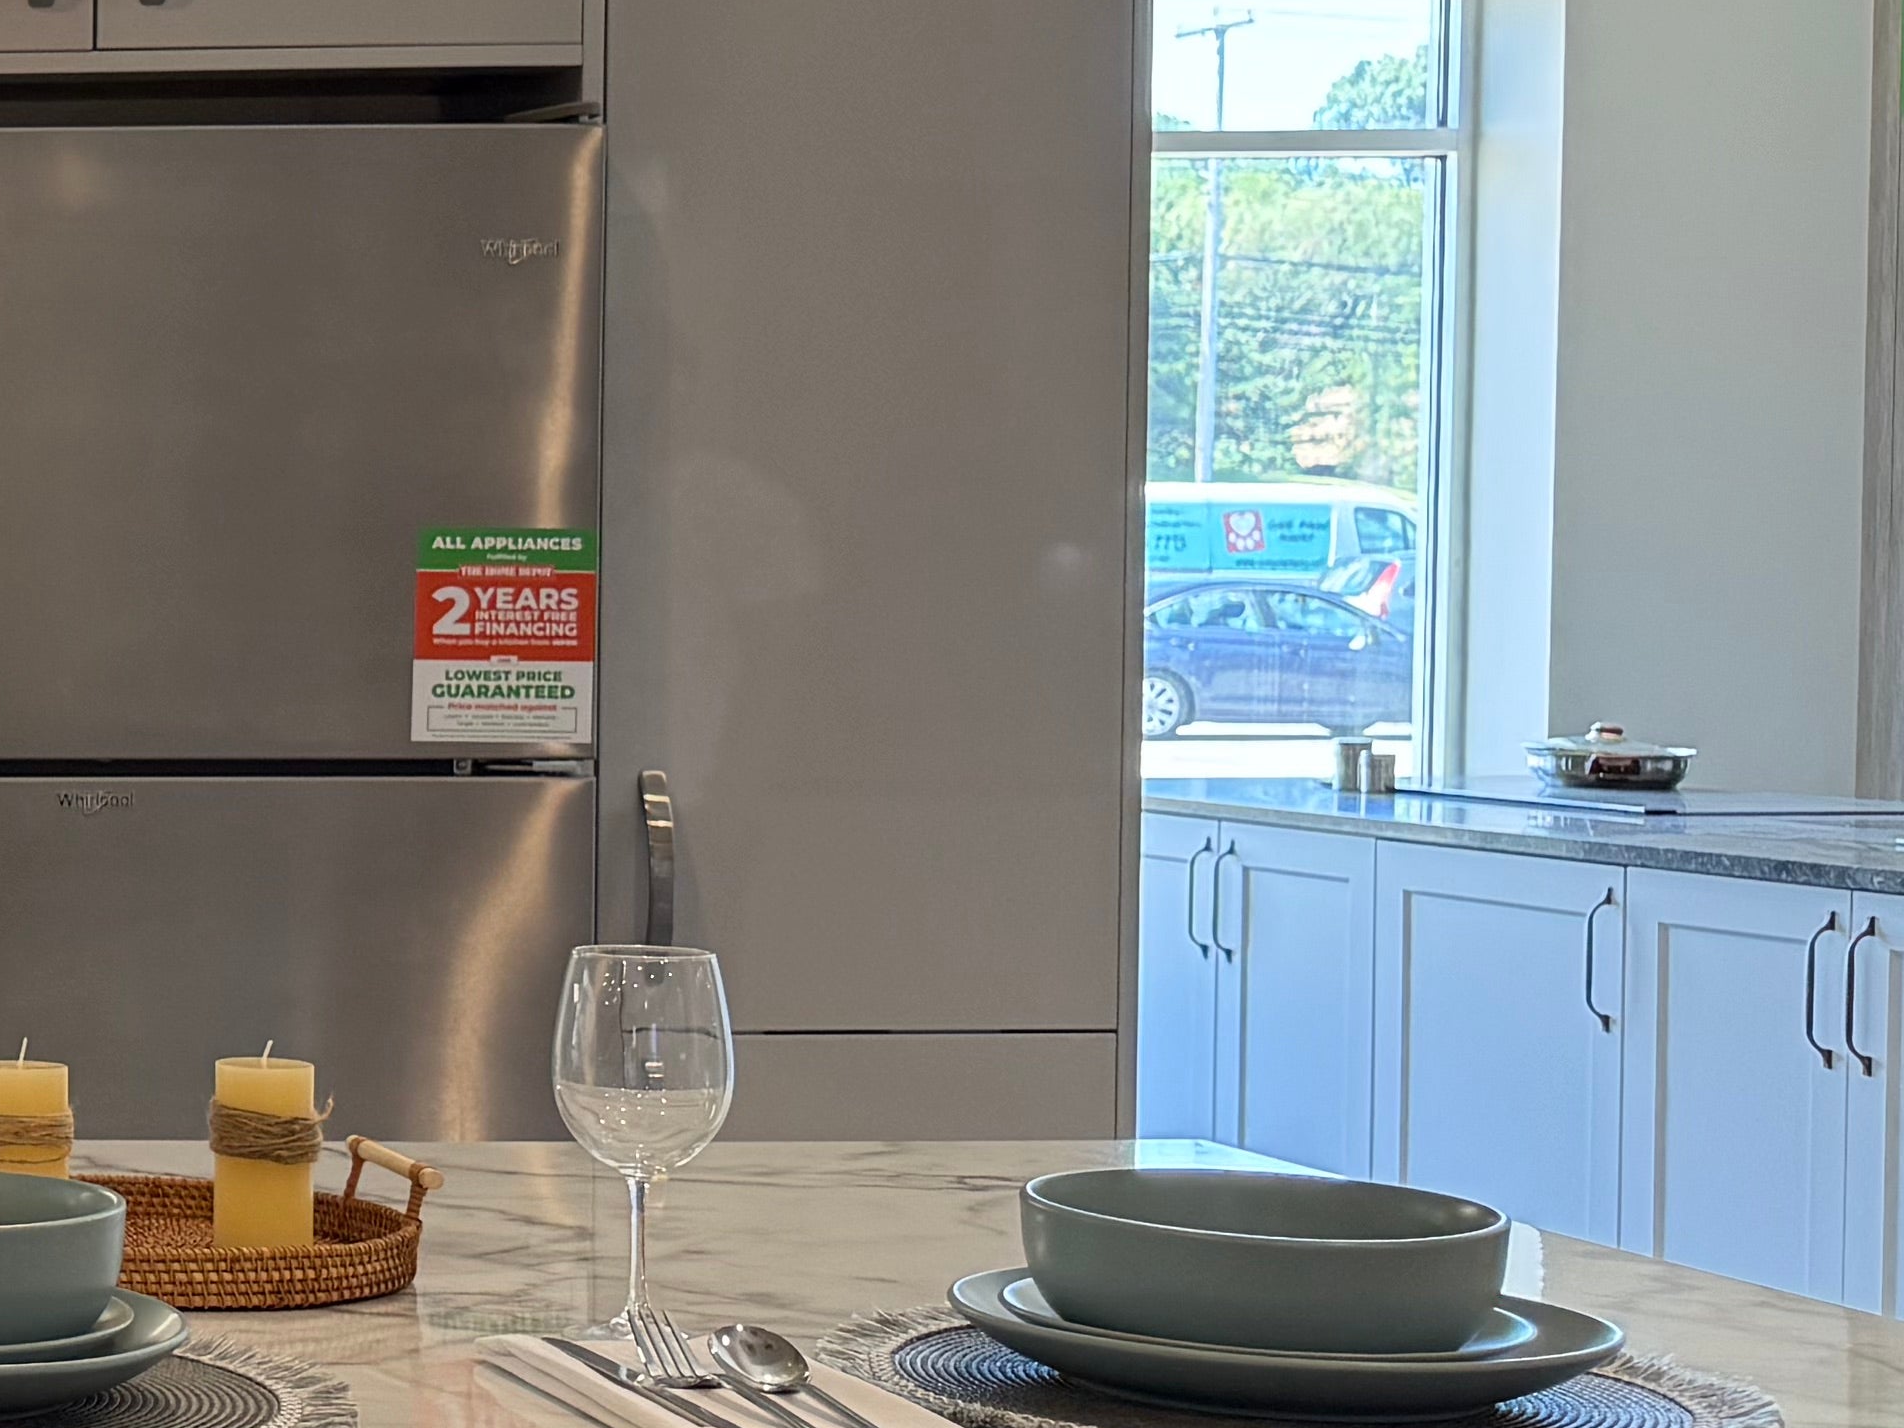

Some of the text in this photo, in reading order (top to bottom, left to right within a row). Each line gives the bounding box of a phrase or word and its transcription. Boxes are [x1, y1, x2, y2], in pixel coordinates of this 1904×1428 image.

[432, 536, 583, 551] ALL APPLIANCES
[461, 566, 483, 577] THE
[485, 566, 517, 577] HOME
[431, 585, 579, 636] 2 YEARS
[475, 610, 577, 621] INTEREST FREE
[475, 622, 578, 637] FINANCING
[445, 669, 563, 683] LOWEST PRICE
[431, 683, 576, 699] GUARANTEED
[448, 702, 558, 713] Price matched against
[56, 790, 135, 811] Whirlpool
